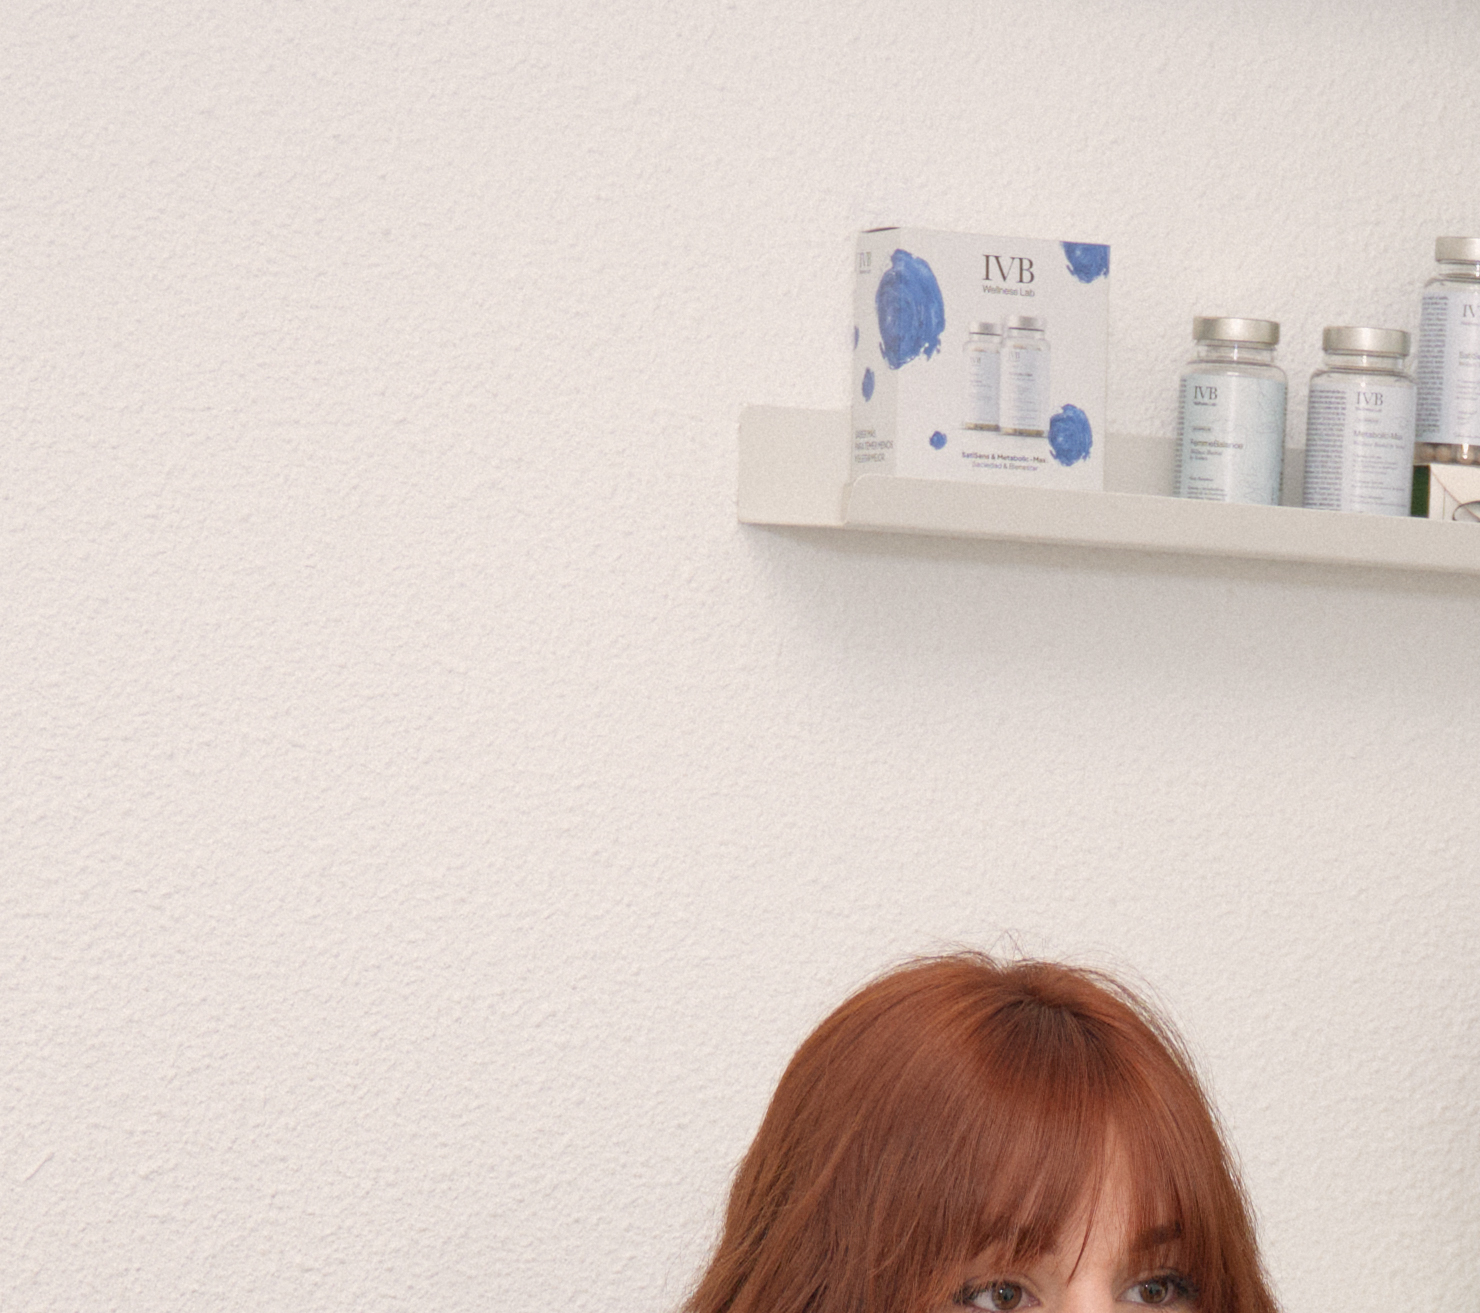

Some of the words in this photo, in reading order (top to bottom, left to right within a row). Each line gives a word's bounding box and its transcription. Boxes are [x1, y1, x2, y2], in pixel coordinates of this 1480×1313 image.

[982, 254, 1035, 284] IVB
[982, 285, 1018, 296] Wellness
[1020, 286, 1035, 297] Lab
[1194, 385, 1218, 400] IVB
[1356, 391, 1384, 406] IVB
